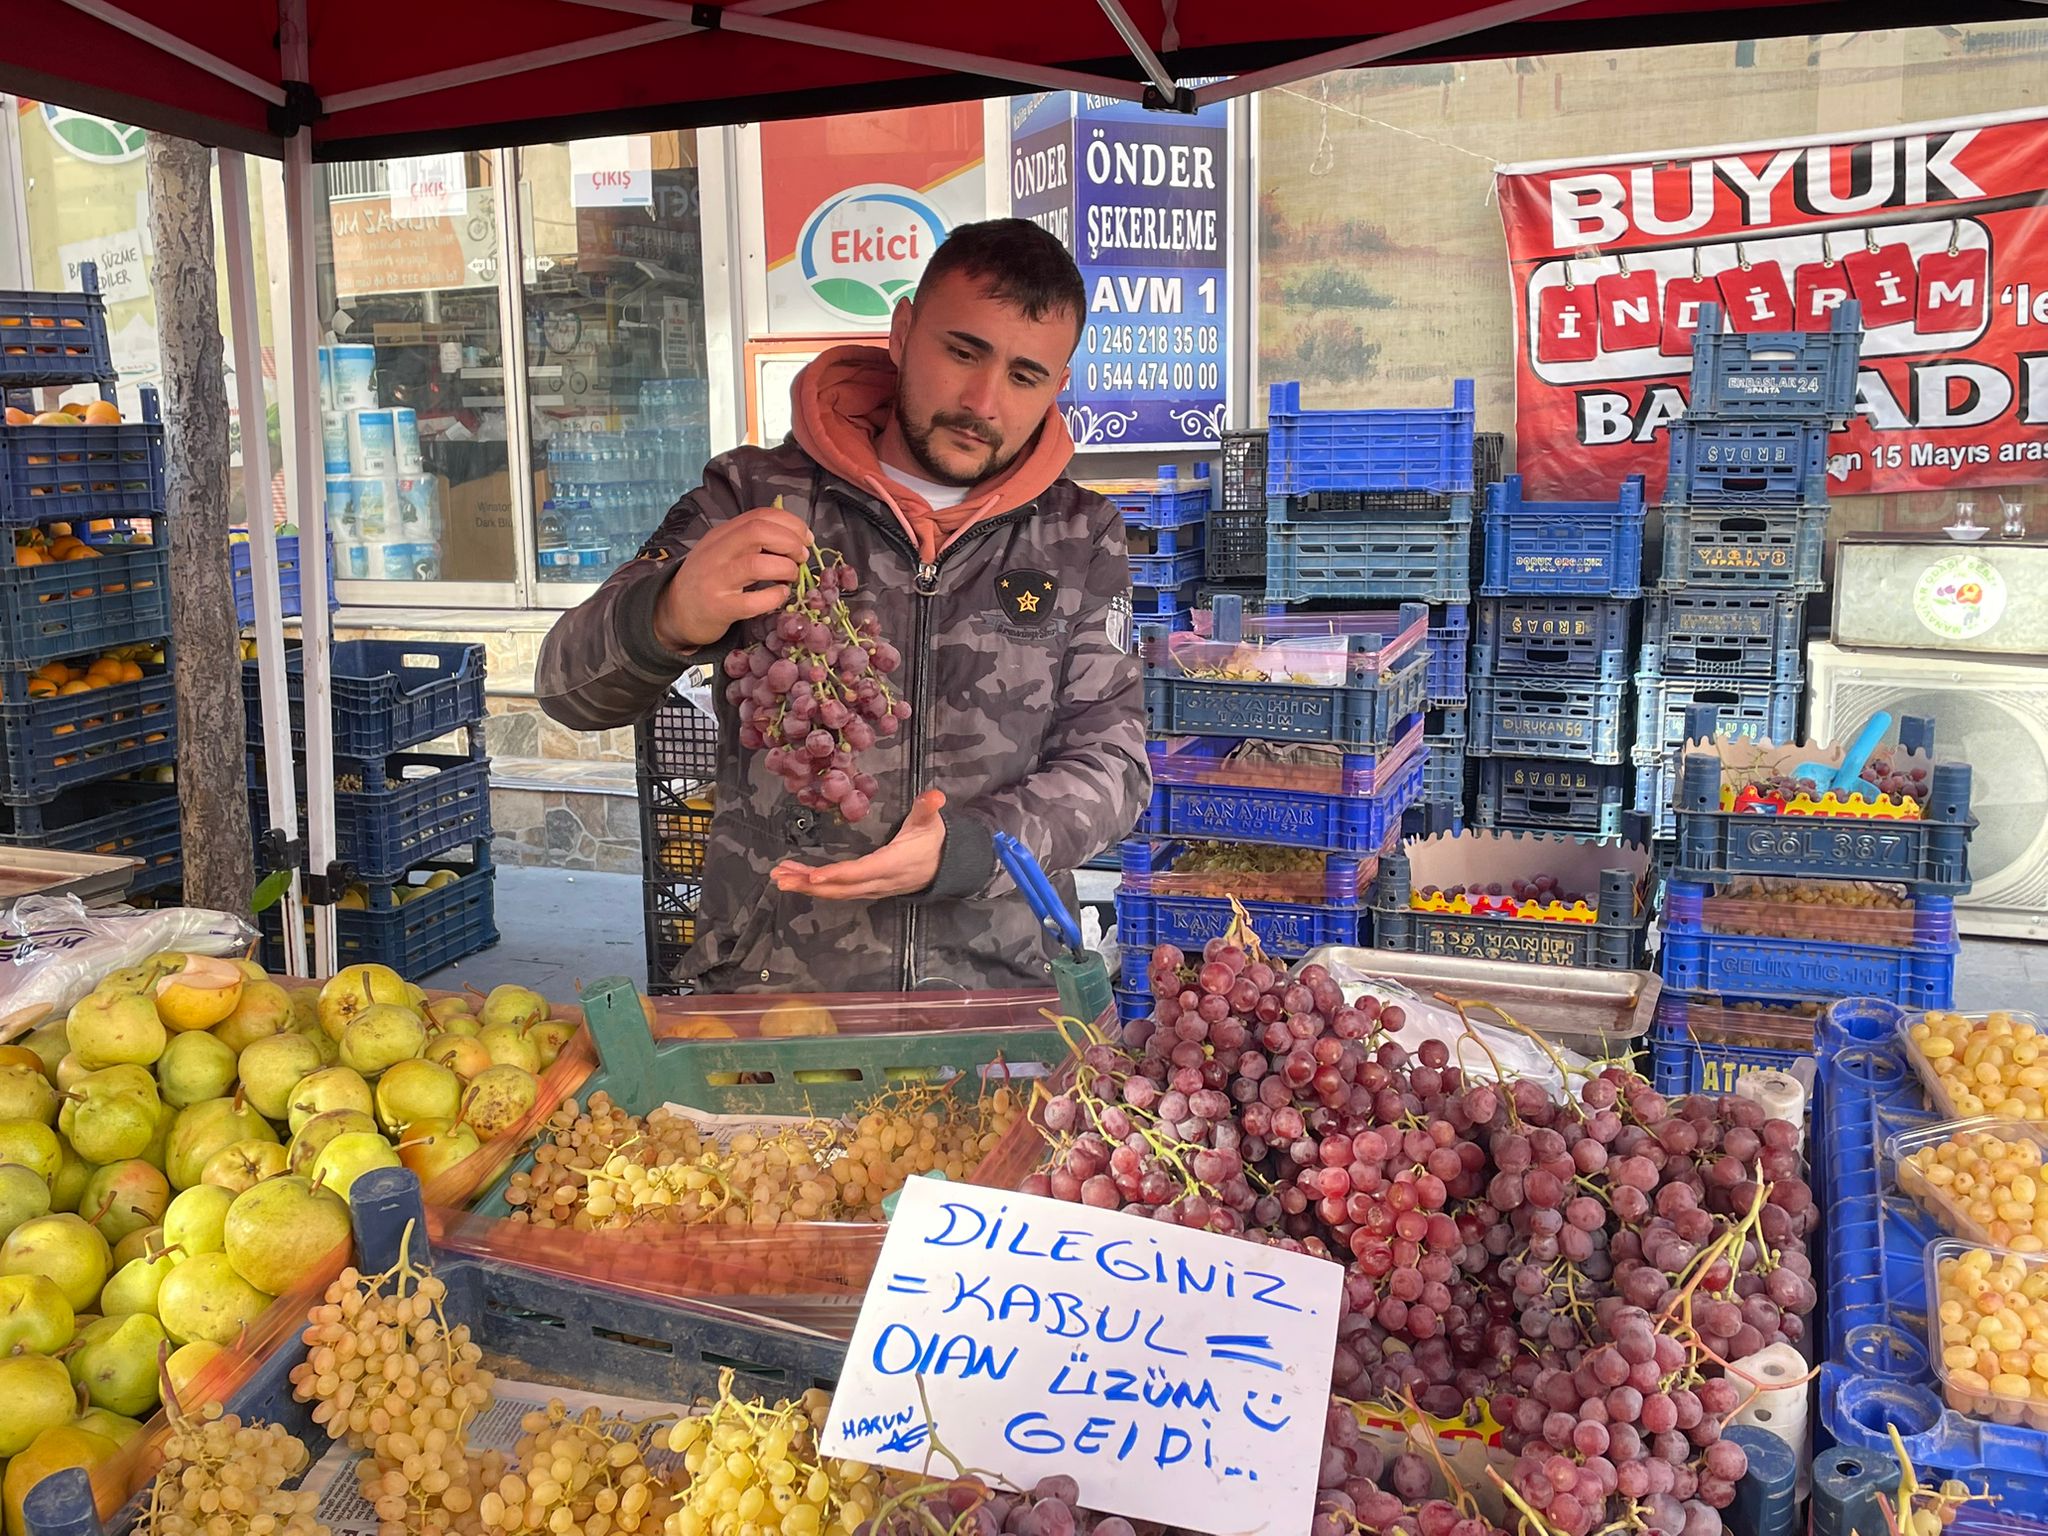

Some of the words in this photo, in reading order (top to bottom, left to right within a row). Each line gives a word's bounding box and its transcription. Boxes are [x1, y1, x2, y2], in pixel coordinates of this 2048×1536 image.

[1014, 144, 1068, 200] ÖNDER
[1086, 128, 1216, 189] ÖNDER
[410, 181, 448, 201] ÇIKIŞ
[592, 170, 632, 190] ÇIKIŞ
[831, 224, 919, 264] Ekici
[1087, 204, 1218, 259] ŞEKERLEME
[101, 247, 138, 270] SÜZME
[1090, 276, 1183, 314] AVM
[1198, 277, 1216, 314] 1
[1087, 325, 1097, 354] 0
[1102, 325, 1133, 354] 246
[1137, 326, 1168, 354] 218
[1173, 326, 1194, 354] 35
[1198, 326, 1218, 354] 08
[1087, 362, 1097, 391] 0
[1102, 362, 1133, 391] 544
[1137, 362, 1168, 391] 474
[1173, 362, 1194, 391] 00
[1198, 362, 1218, 391] 00
[1797, 377, 1820, 393] 24
[1871, 445, 1903, 469] 15
[1910, 442, 1990, 470] Mayıs
[1217, 711, 1294, 726] TARIM
[1502, 718, 1564, 733] DURUKAN
[1187, 801, 1314, 825] KANATLAR
[1204, 818, 1231, 826] HAL
[1747, 830, 1824, 858] GÖL
[1833, 832, 1901, 861] 387
[943, 1271, 1189, 1356] KABUL
[1048, 1352, 1222, 1413] ÜZÜM
[842, 1405, 914, 1441] HARUN
